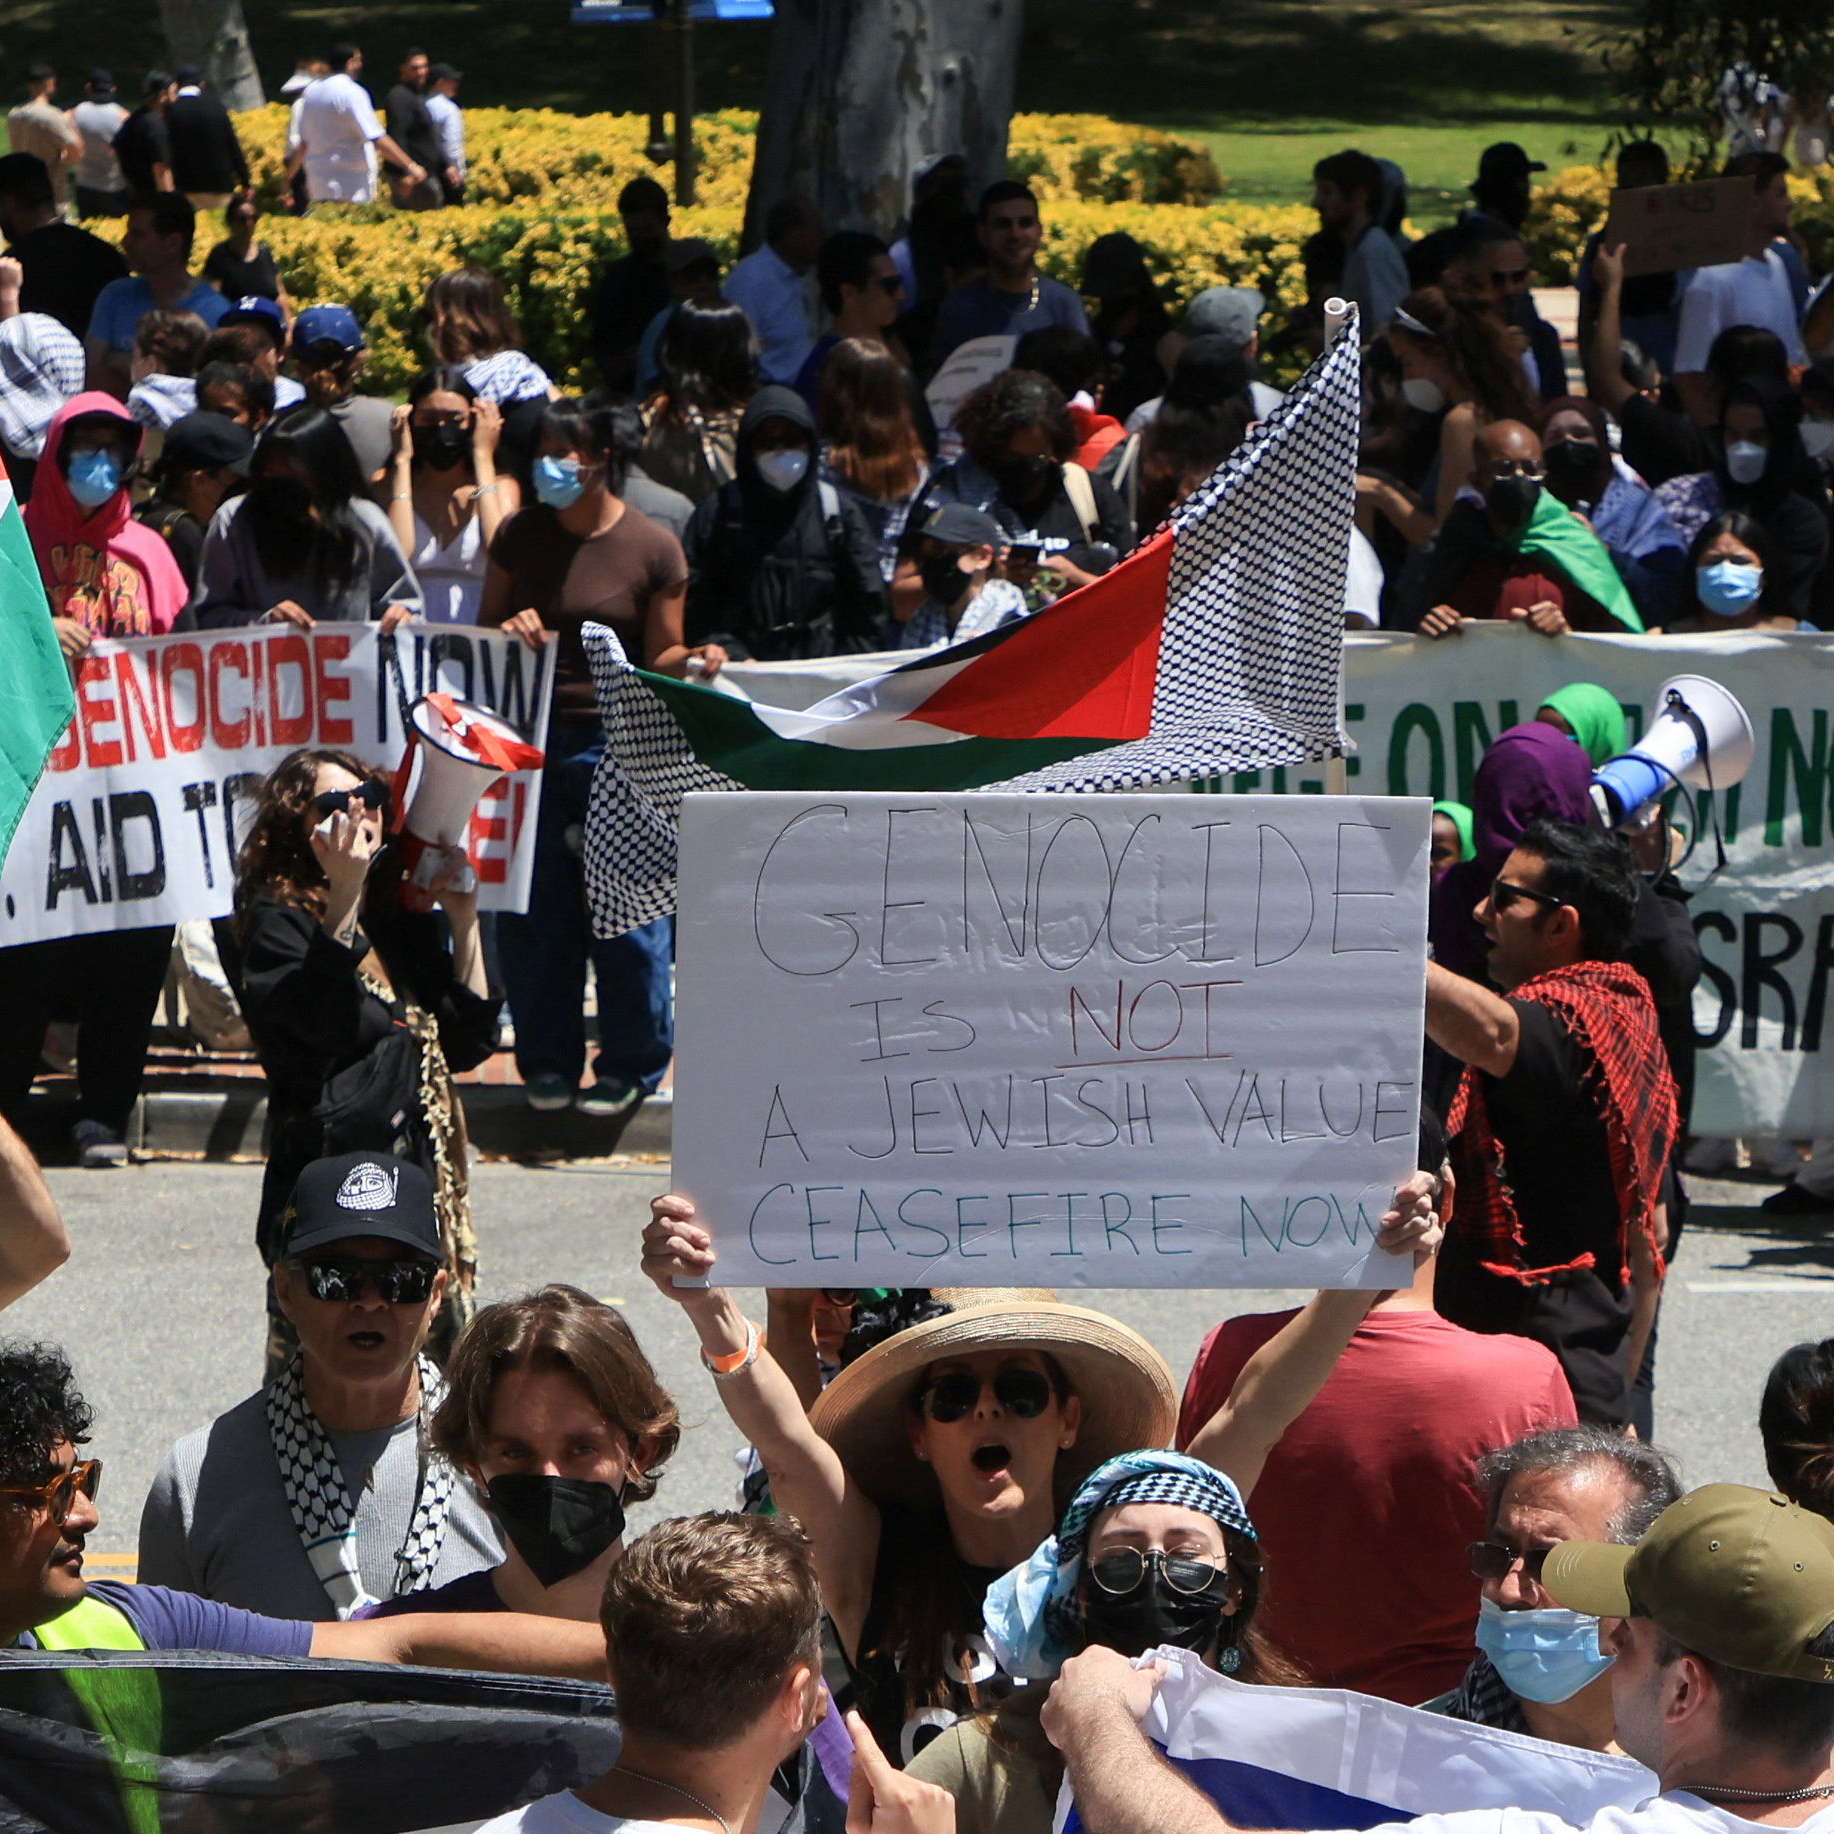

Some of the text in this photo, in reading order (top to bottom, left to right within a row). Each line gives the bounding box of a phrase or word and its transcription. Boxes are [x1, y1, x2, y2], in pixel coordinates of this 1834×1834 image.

[46, 790, 166, 911] AID
[754, 804, 1399, 976] GENOCIDE
[850, 979, 1244, 1063] IS NOT
[758, 1068, 1414, 1168] A JEWISH VALUE
[749, 1182, 1397, 1265] CEASEFIRE NOW
